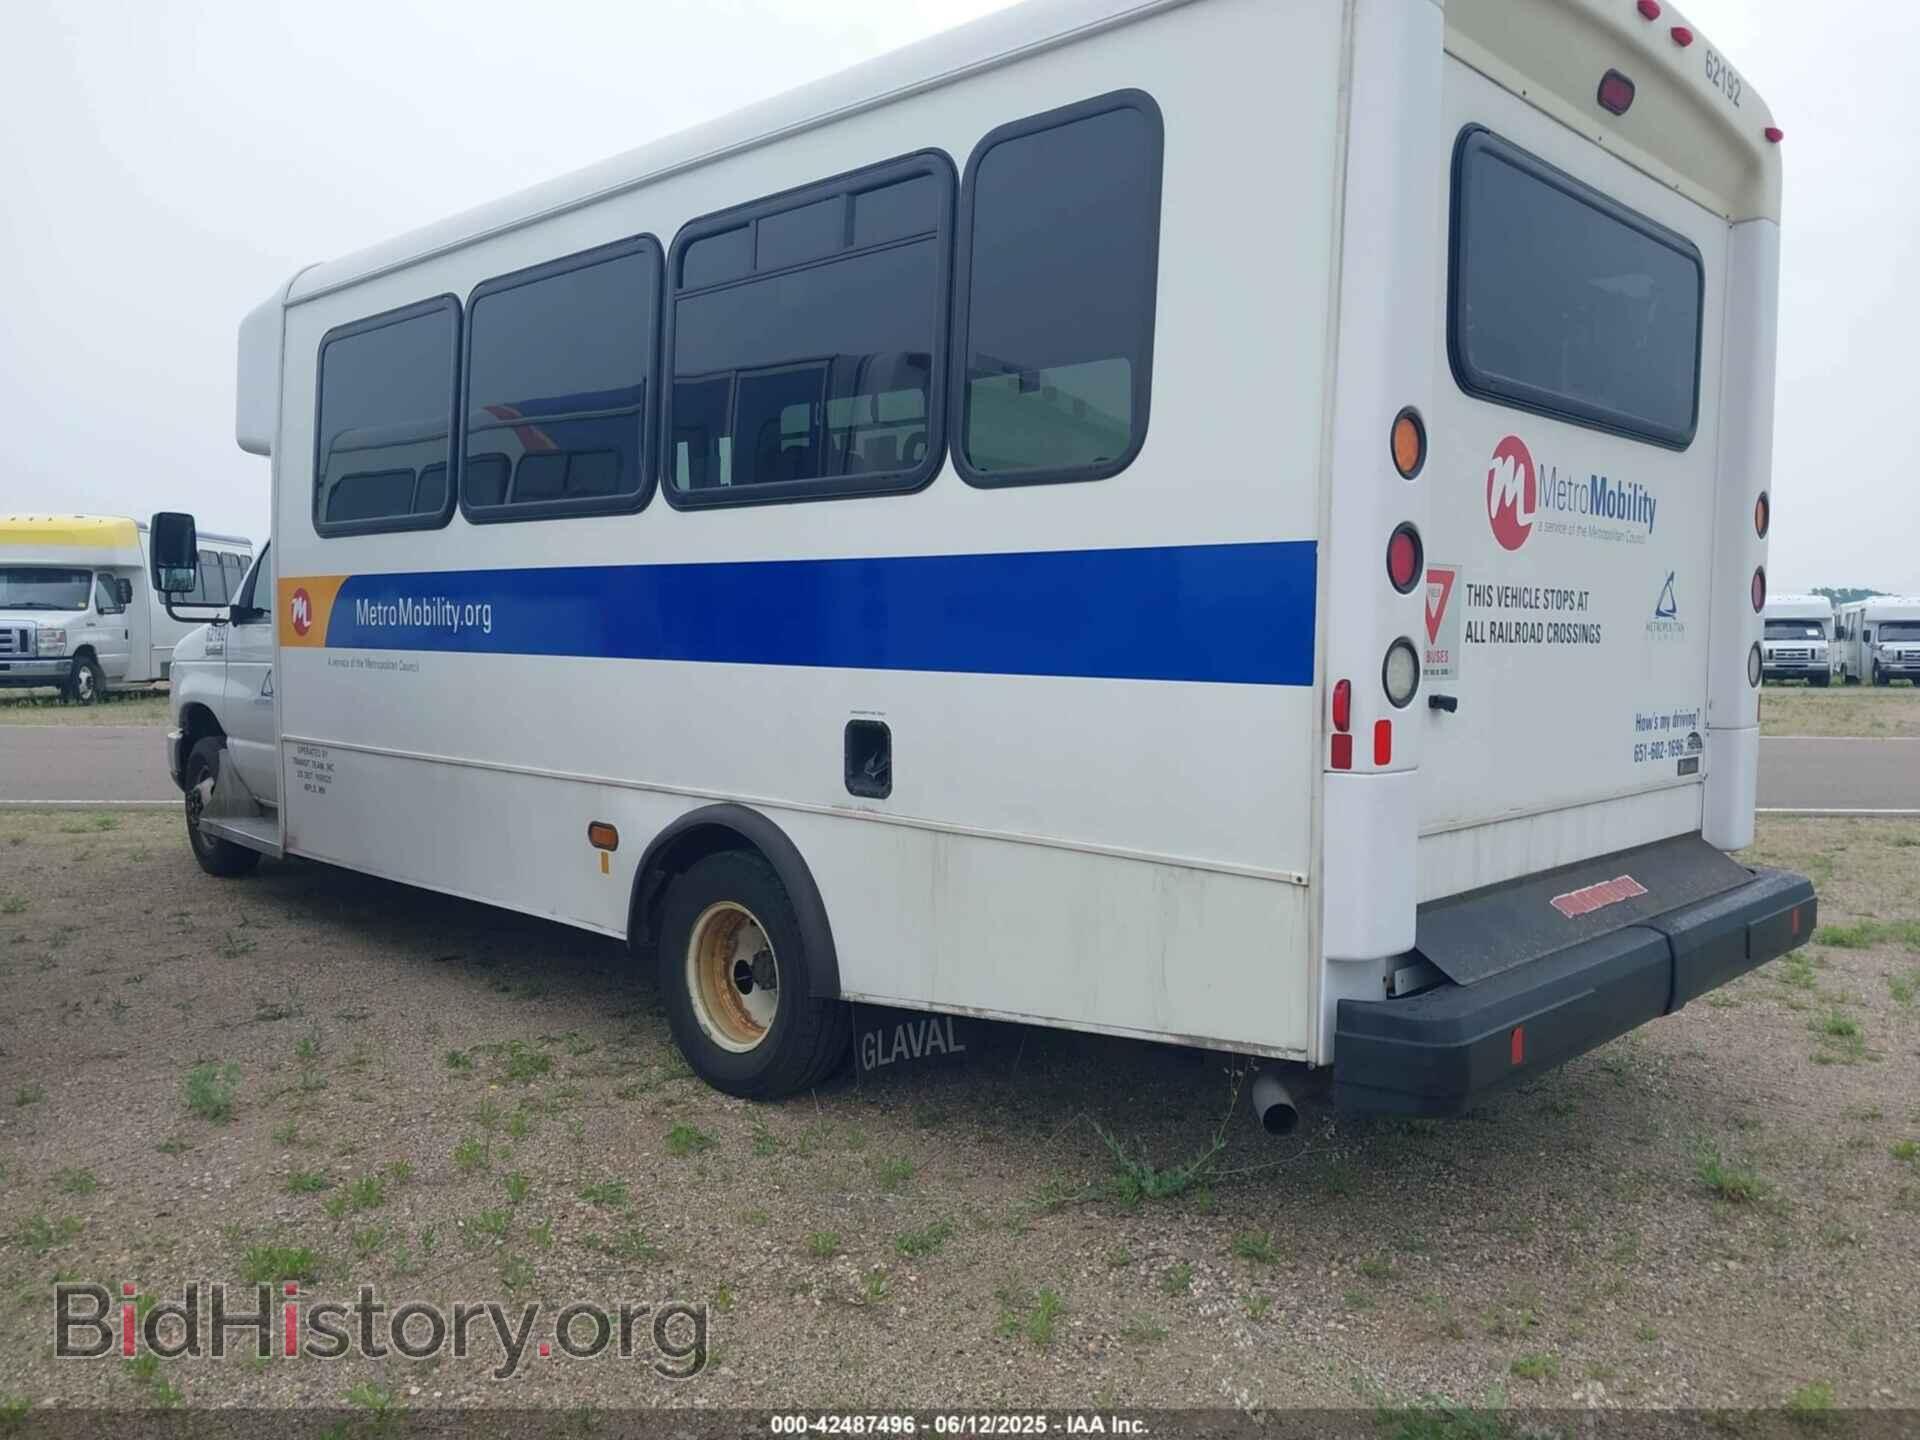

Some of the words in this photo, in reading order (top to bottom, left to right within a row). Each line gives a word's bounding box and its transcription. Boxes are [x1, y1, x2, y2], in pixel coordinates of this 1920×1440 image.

[1705, 48, 1742, 108] 62192
[1538, 463, 1656, 534] MetroMobility
[355, 597, 492, 634] MetroMobility.org
[1466, 583, 1494, 608] THIS
[1497, 585, 1541, 610] VEHICLE
[1543, 588, 1576, 611] STOPS
[1577, 591, 1590, 612] AT
[1465, 620, 1486, 644] ALL
[1489, 621, 1544, 644] RAILROAD
[1547, 623, 1602, 645] CROSSINGS
[1635, 711, 1658, 732] How's
[1660, 716, 1671, 732] my
[862, 1016, 966, 1071] GLAVAL
